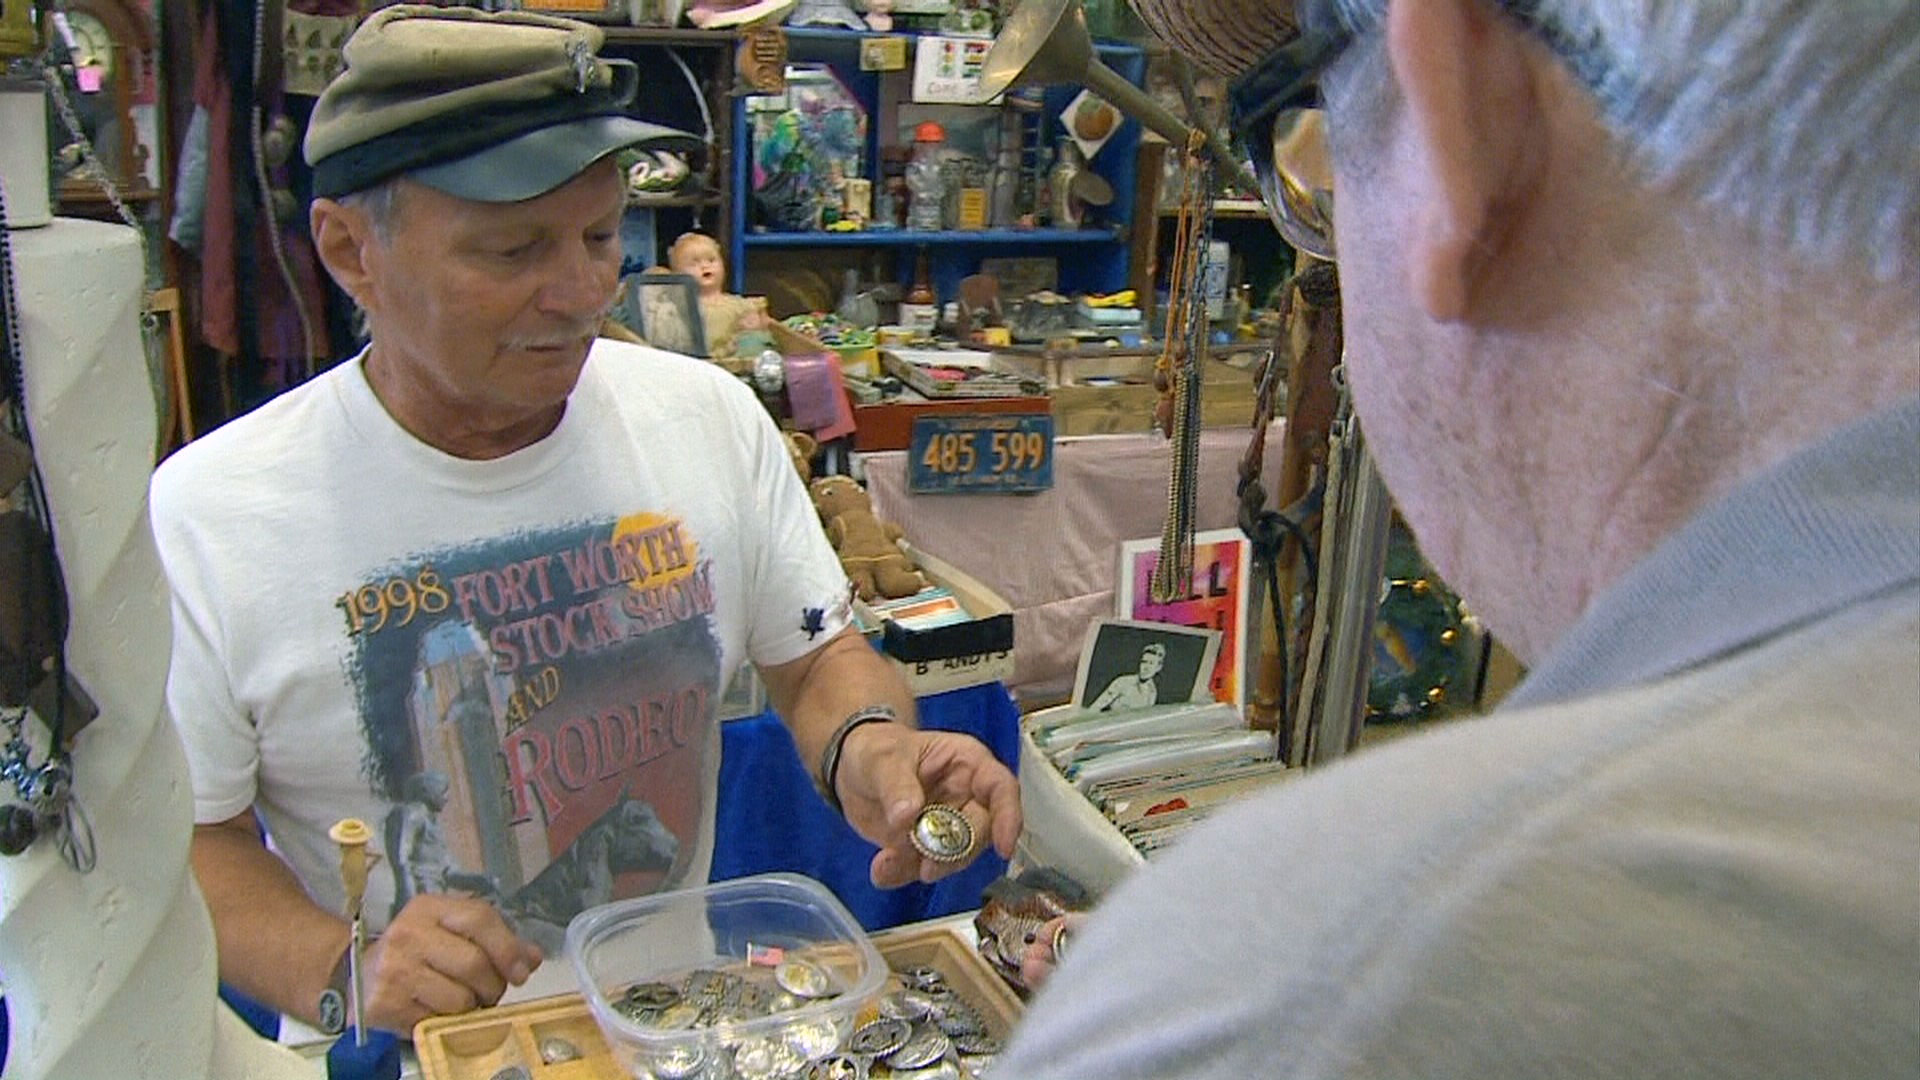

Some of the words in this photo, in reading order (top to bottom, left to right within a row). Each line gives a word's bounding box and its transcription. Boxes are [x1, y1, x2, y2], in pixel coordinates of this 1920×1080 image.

[922, 432, 977, 475] 485
[992, 430, 1045, 474] 599
[336, 564, 450, 637] 1998
[452, 556, 556, 626] FORT
[559, 520, 690, 595] WORTH
[490, 596, 625, 675] STOCK
[622, 558, 718, 638] SHOW
[506, 664, 562, 730] AND
[502, 683, 707, 826] RODEO
